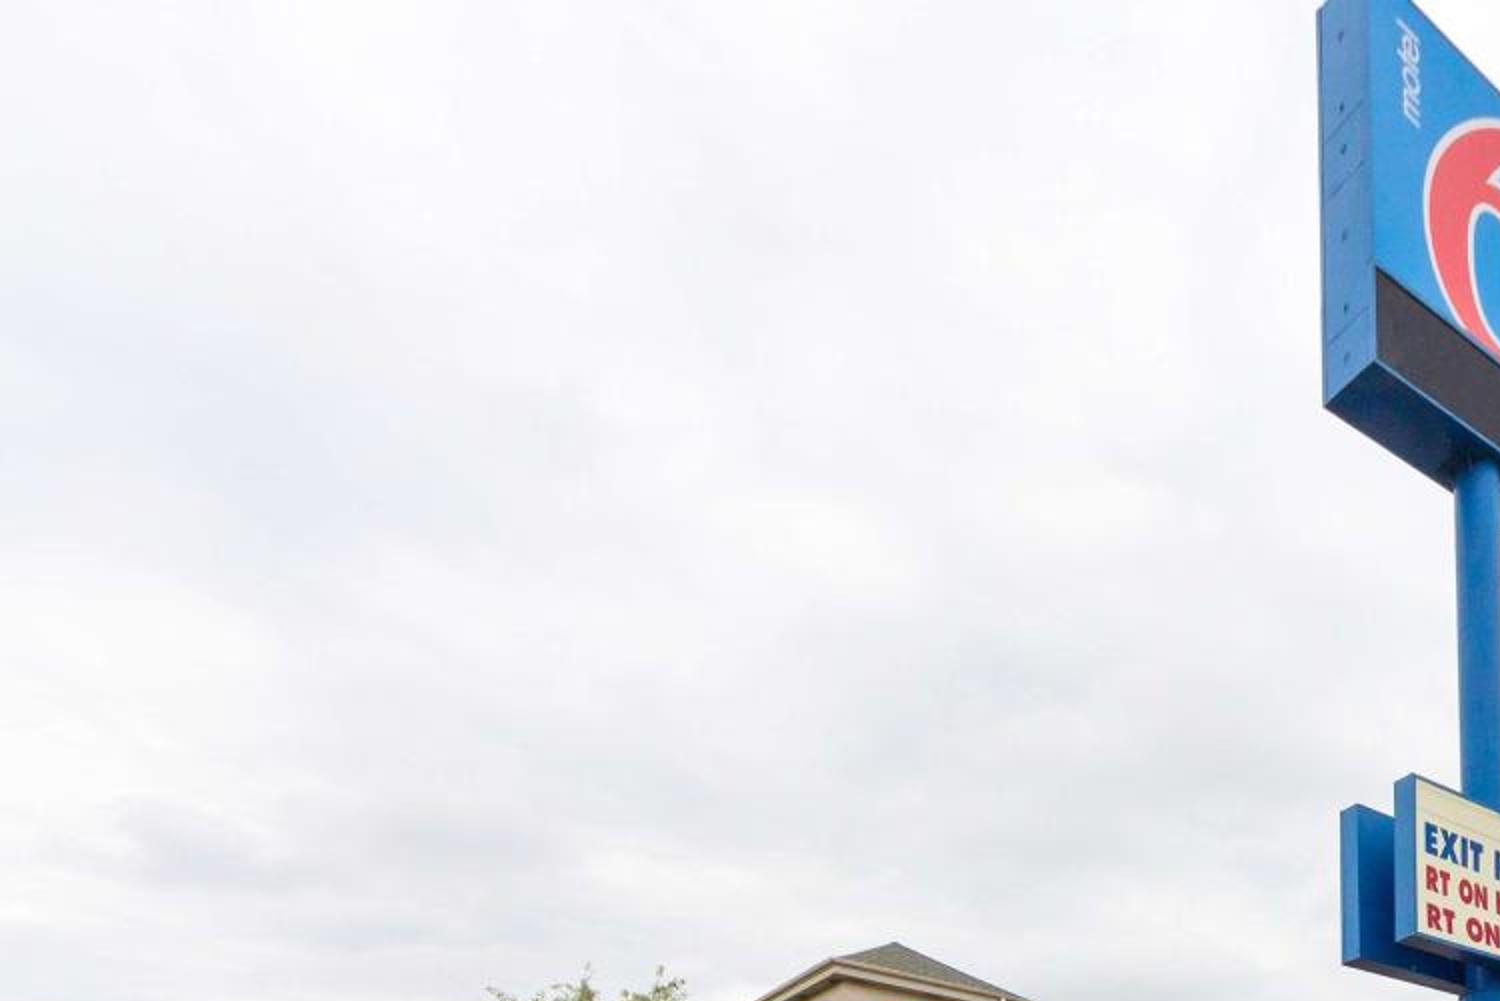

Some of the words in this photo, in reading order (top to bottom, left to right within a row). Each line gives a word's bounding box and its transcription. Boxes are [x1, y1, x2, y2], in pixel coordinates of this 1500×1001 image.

[1397, 18, 1421, 128] motel
[1424, 821, 1484, 873] EXIT
[1425, 865, 1451, 896] RT
[1459, 878, 1489, 910] ON
[1426, 903, 1455, 934] RT
[1465, 918, 1500, 949] ON
